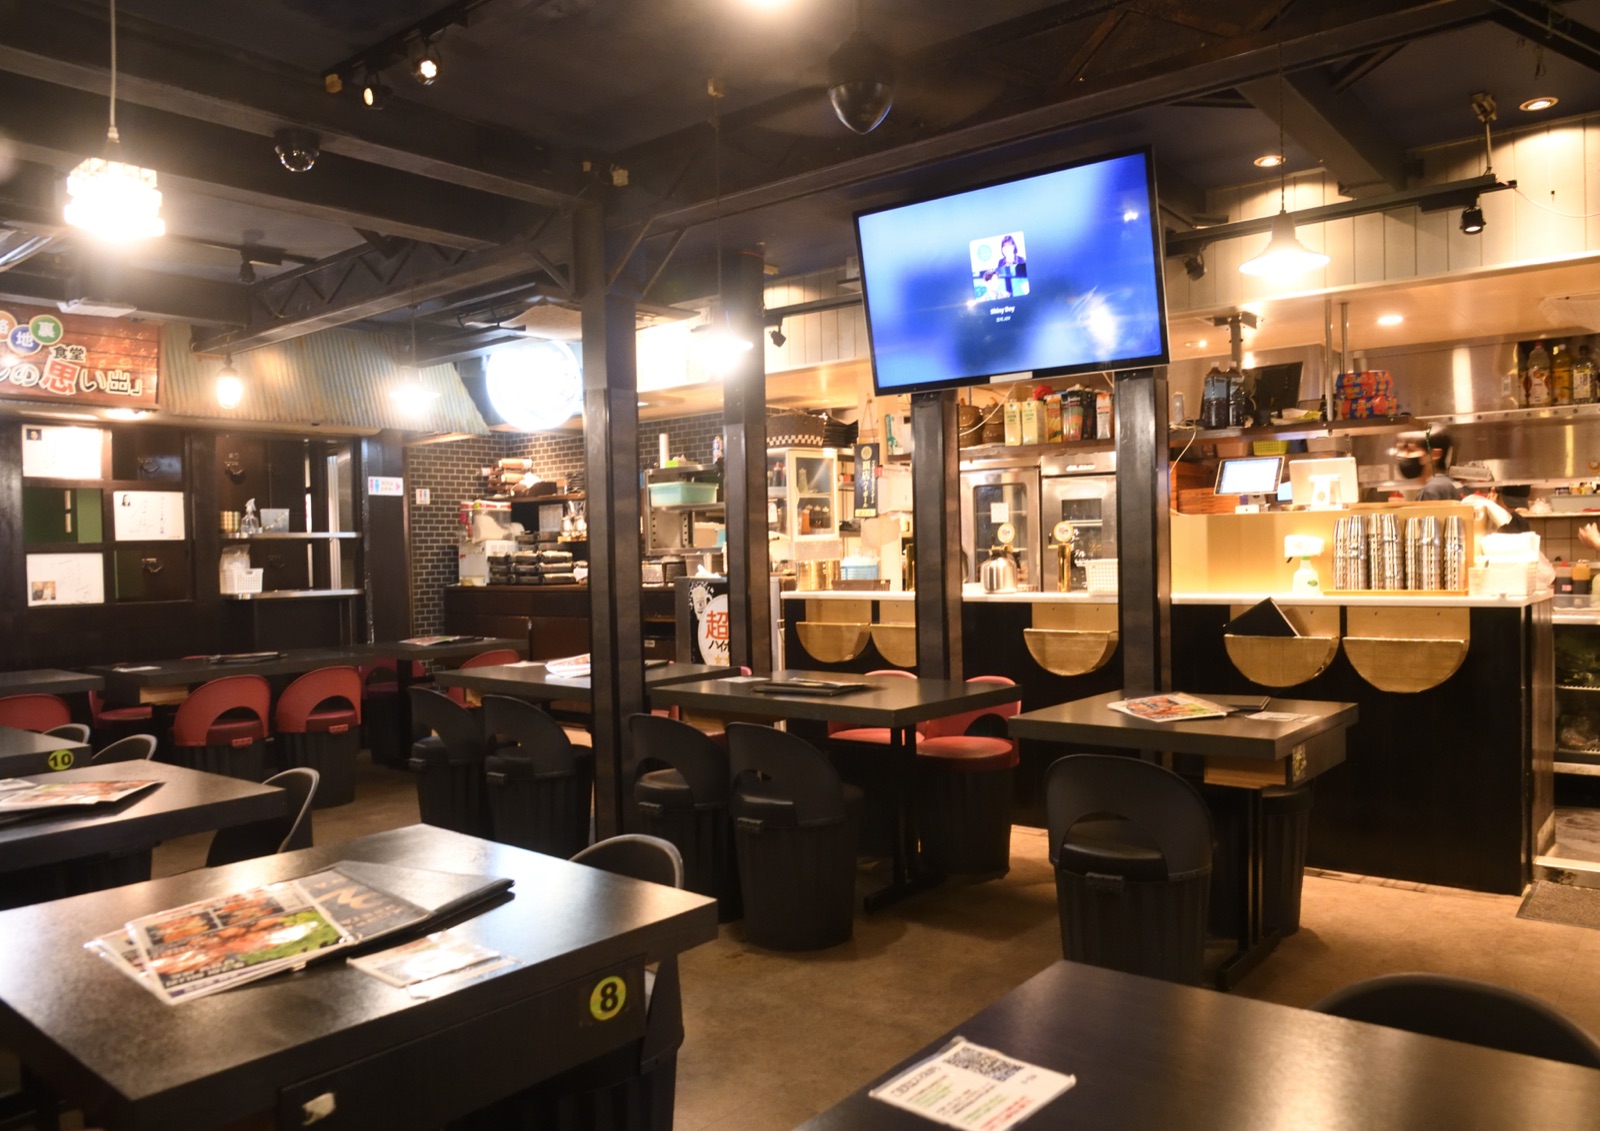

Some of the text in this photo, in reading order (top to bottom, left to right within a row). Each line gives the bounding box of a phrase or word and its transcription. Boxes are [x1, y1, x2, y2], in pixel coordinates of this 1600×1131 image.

[53, 346, 85, 362] 食堂
[705, 610, 729, 640] 超
[49, 753, 72, 768] 10
[600, 981, 619, 1013] 8
